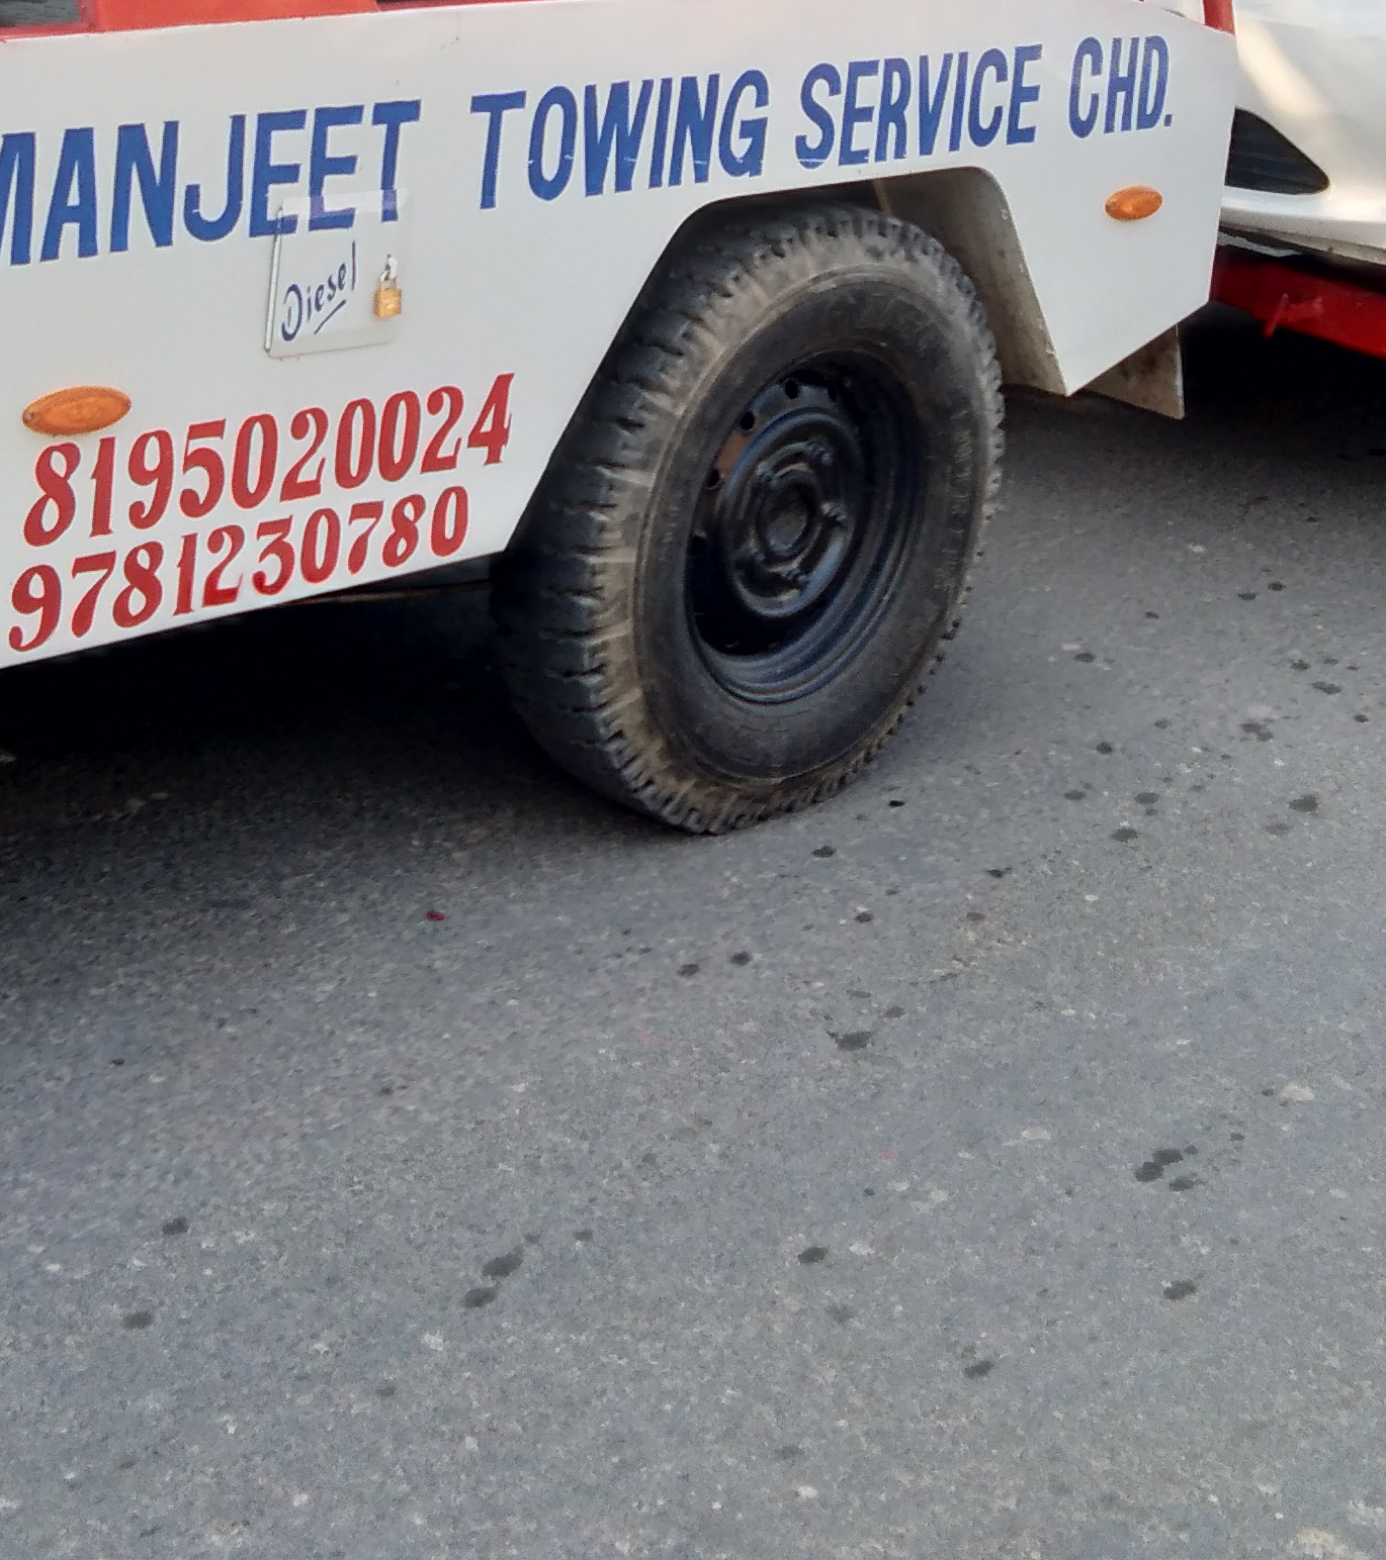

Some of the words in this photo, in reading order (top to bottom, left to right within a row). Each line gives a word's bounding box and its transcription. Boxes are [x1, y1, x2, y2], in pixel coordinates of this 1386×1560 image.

[470, 68, 770, 211] TOWING
[793, 43, 1044, 170] SERVICE
[1066, 35, 1174, 140] CHD.
[280, 240, 357, 342] Diesel
[22, 372, 515, 547] 8195020024
[7, 485, 470, 653] 9781230780
